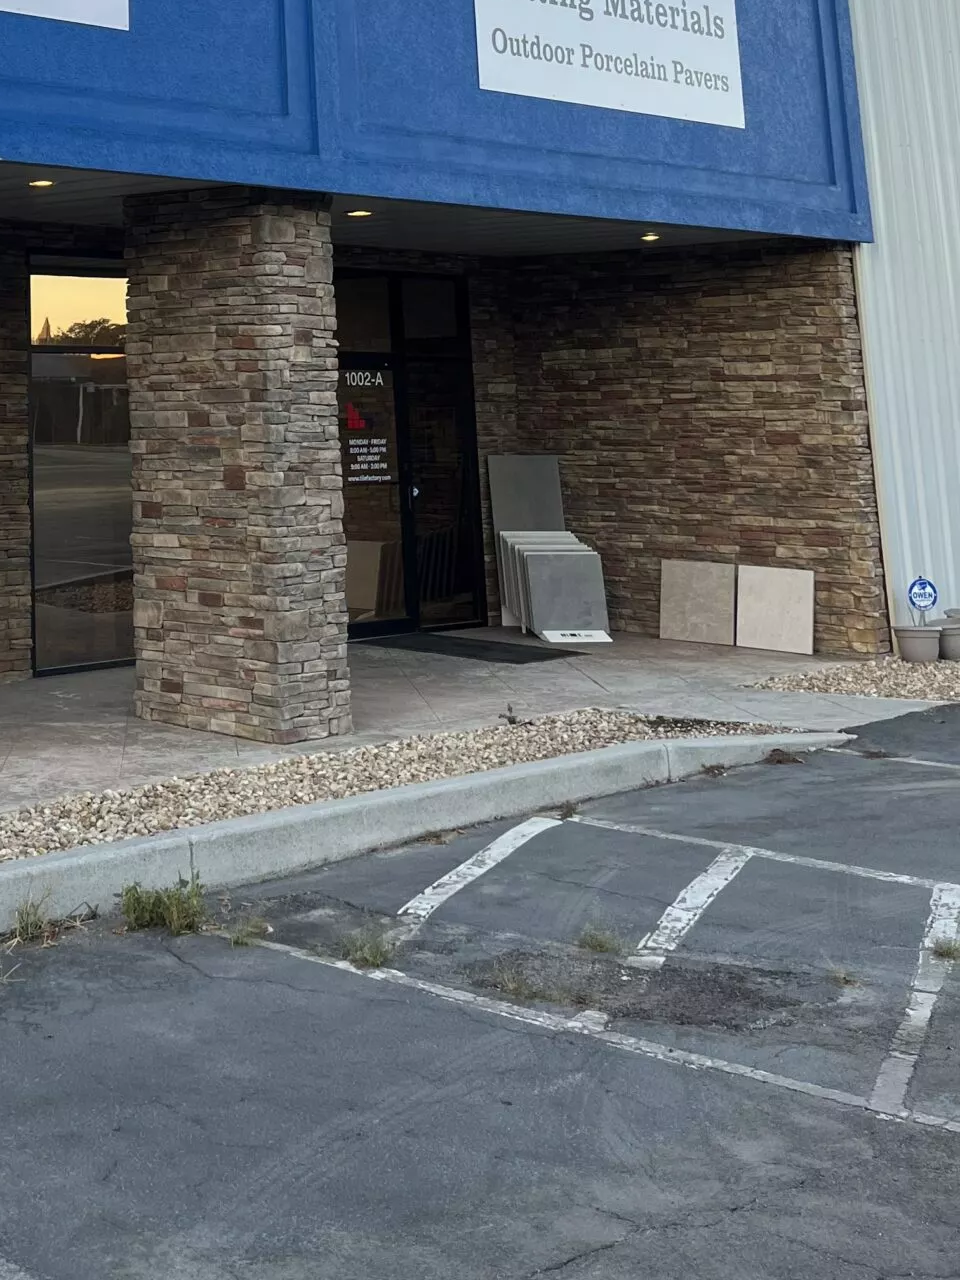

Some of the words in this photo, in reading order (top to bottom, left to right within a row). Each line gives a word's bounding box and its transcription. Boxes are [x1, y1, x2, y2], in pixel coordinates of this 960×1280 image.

[491, 27, 575, 66] Outdoor
[579, 43, 669, 82] Porcelain
[671, 60, 730, 93] Pavers
[344, 371, 384, 386] 1002-A
[348, 438, 369, 446] MONDAY
[370, 437, 387, 445] FRIDAY
[356, 454, 381, 462] SATURDAY
[912, 591, 934, 599] OWEN
